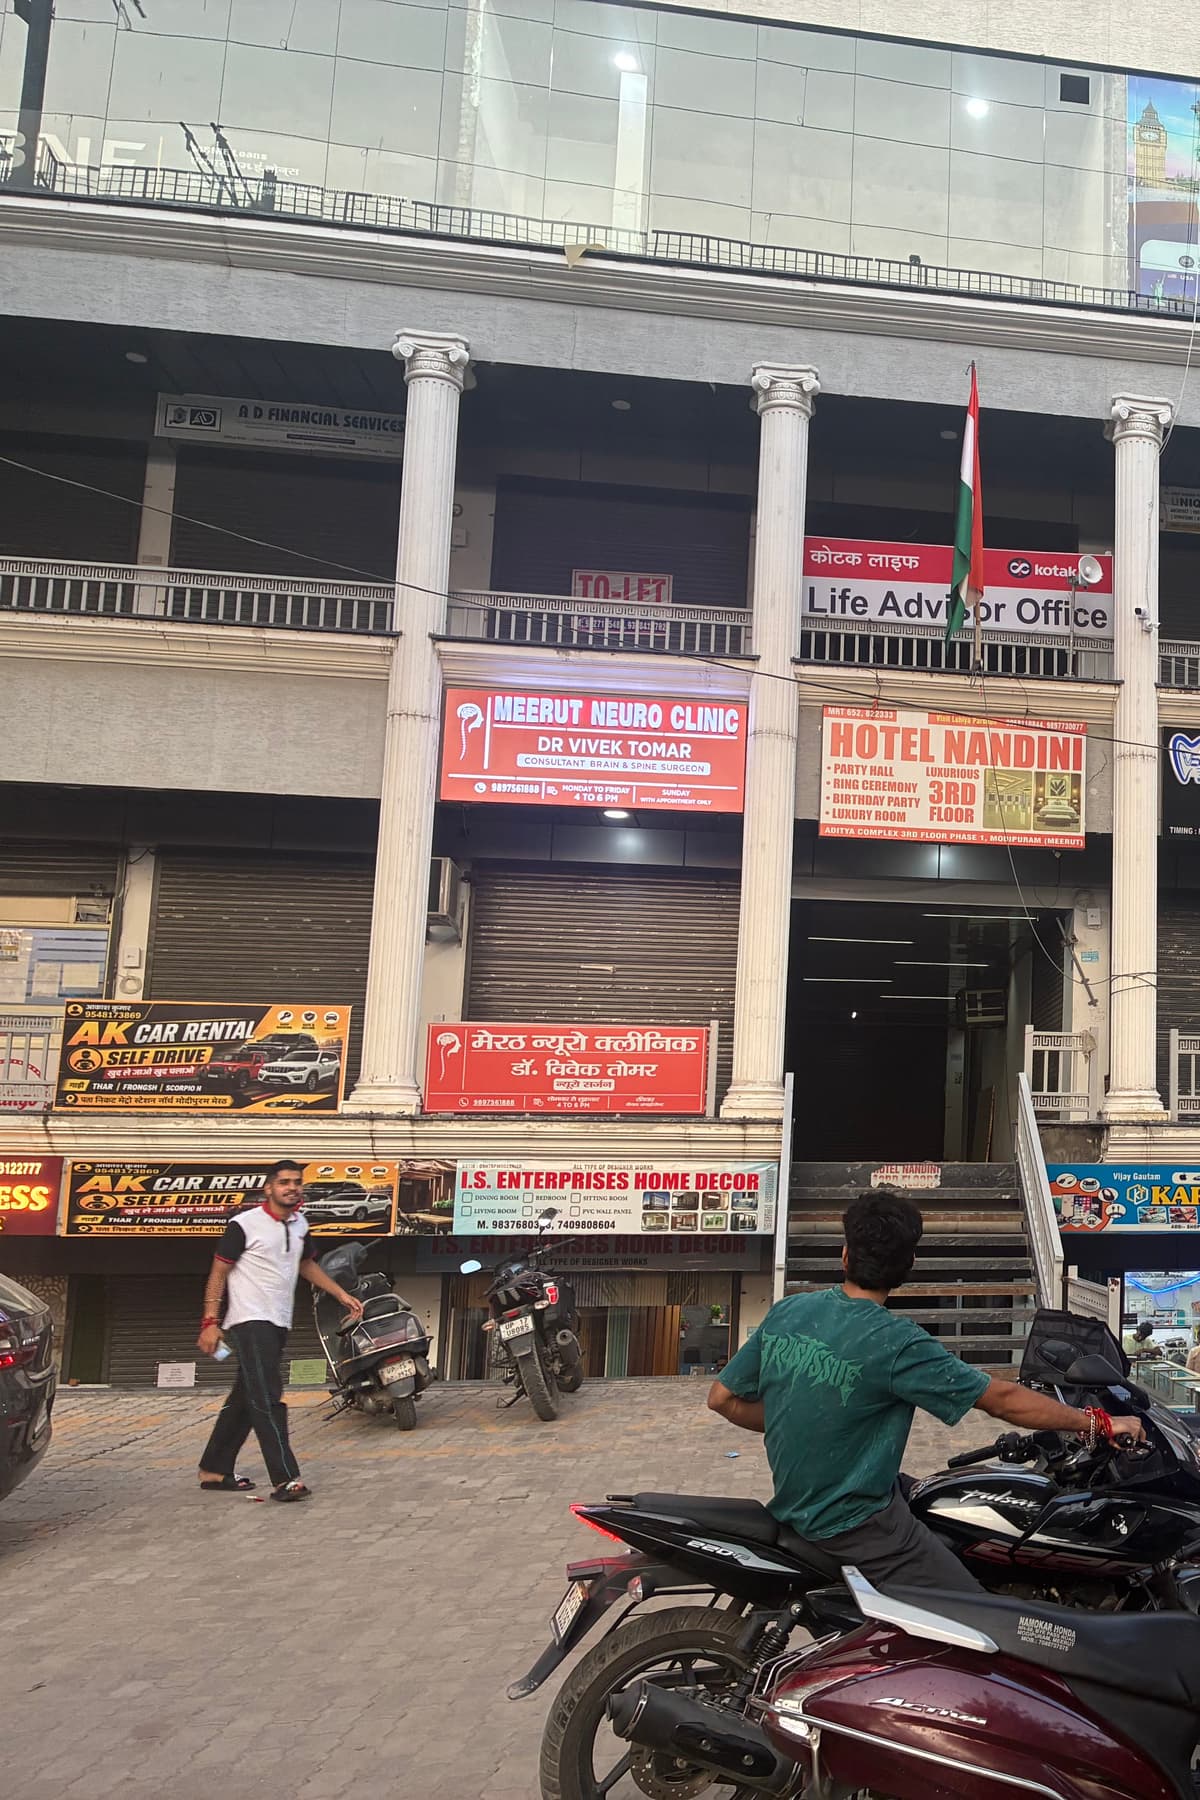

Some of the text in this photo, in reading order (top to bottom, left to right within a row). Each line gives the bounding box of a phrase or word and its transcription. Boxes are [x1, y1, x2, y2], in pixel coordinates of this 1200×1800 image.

[238, 405, 405, 433] A D FINANCIAL SERVICES
[810, 546, 919, 572] कोटक लाइफ
[1035, 564, 1076, 577] kotak
[809, 586, 868, 615] Life
[1017, 598, 1107, 628] Office
[495, 696, 739, 734] MEERUT NEURO CLINIC
[538, 736, 692, 758] DR VIVEK TOMAR
[830, 723, 1082, 770] HOTEL NANDINI
[525, 757, 585, 768] CONSULTANT
[590, 760, 619, 769] BRAIN
[631, 762, 656, 772] SPINE
[661, 763, 704, 773] SURGEON
[834, 765, 894, 777] PARTY HALL
[926, 767, 979, 780] LUXURIOUS
[834, 779, 917, 793] RING CEREMONY
[929, 780, 976, 806] 3RD
[833, 794, 920, 808] BIRTHDAY PARTY
[832, 809, 906, 822] LUXURY ROOM
[929, 806, 974, 823] FLOOR
[67, 1020, 254, 1046] AK CAR RENTAL
[471, 1030, 698, 1056] मेरठ न्यूरो क्लीनिक
[107, 1051, 205, 1066] SELF DRIVE
[511, 1059, 658, 1077] डॉ. विवेक तोमर
[556, 1080, 612, 1089] न्यूरो सर्जन
[76, 1174, 265, 1192] AK CAR RENT
[461, 1171, 758, 1190] I.S. ENTERPRISES HOME DECOR
[1113, 1172, 1131, 1182] Vijay
[123, 1194, 235, 1205] SELF DRIVE
[1019, 1616, 1076, 1638] NAMOKAR HONDA
